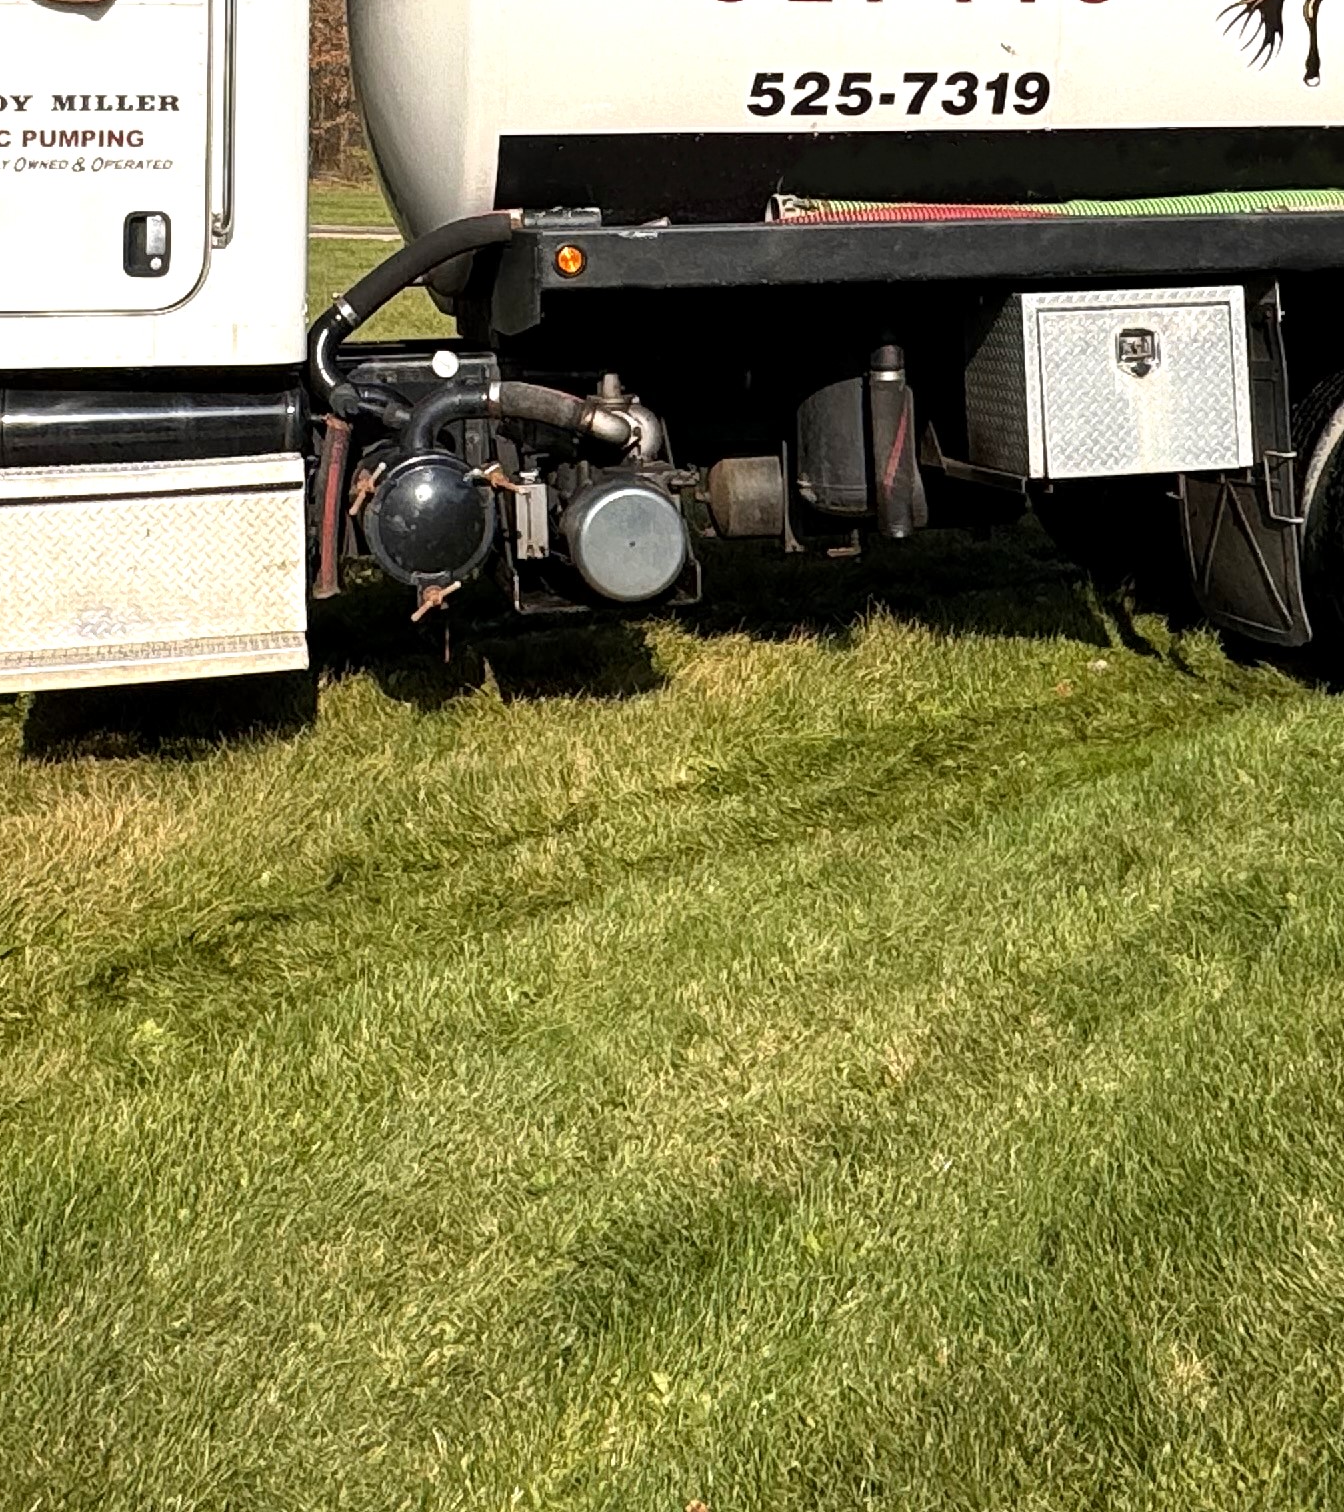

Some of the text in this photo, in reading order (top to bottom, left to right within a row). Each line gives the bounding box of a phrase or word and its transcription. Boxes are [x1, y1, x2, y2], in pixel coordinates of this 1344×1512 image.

[51, 94, 180, 113] MILLER
[747, 71, 1051, 117] 525-7319
[22, 129, 145, 148] PUMPING
[72, 156, 86, 172] &
